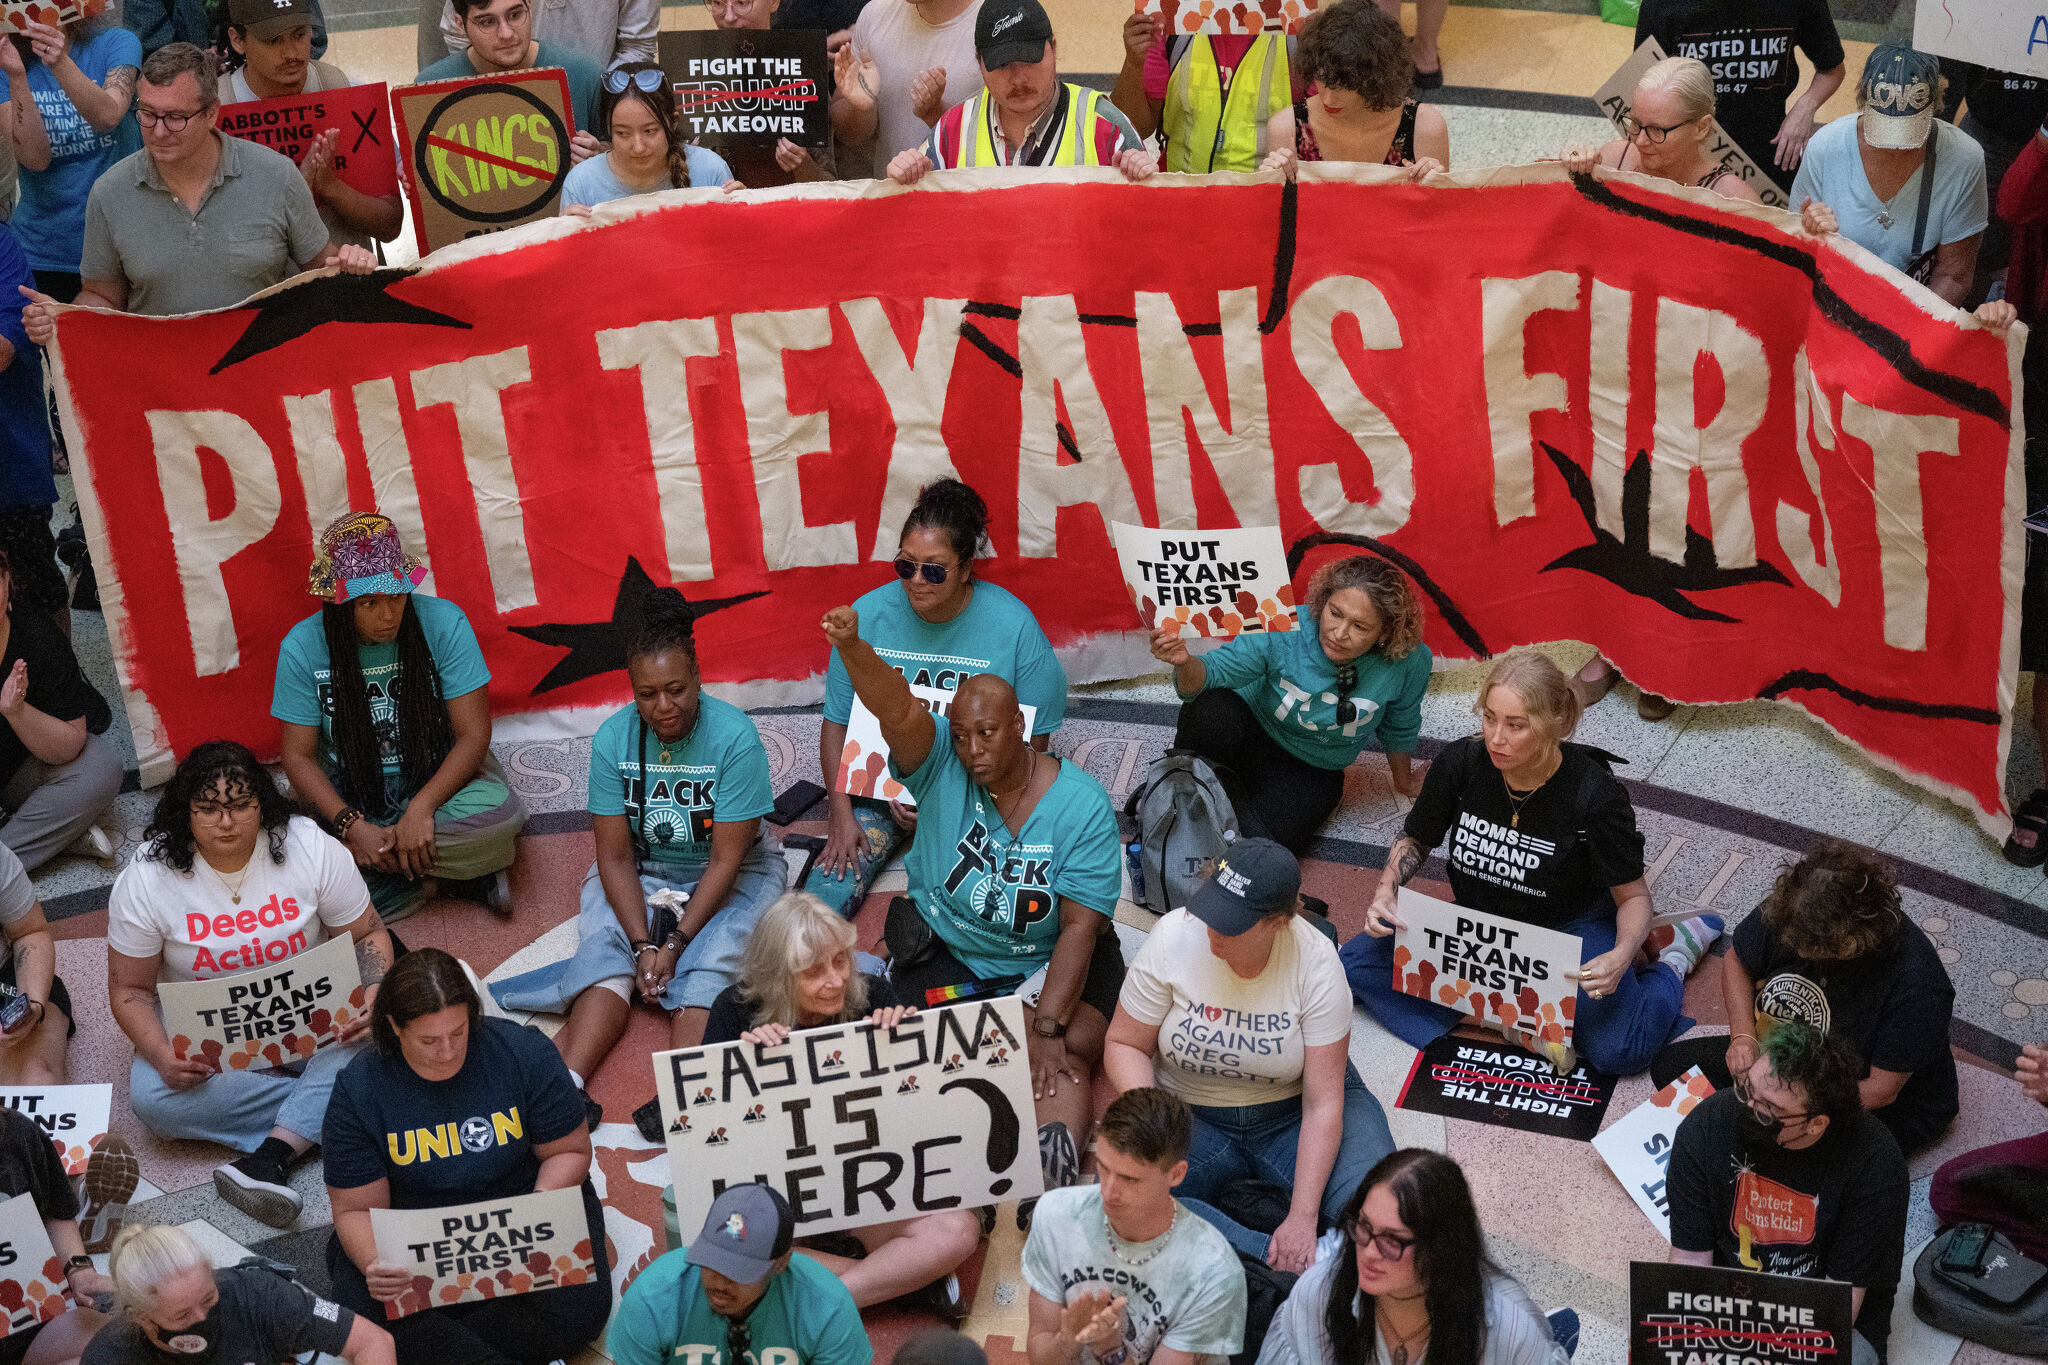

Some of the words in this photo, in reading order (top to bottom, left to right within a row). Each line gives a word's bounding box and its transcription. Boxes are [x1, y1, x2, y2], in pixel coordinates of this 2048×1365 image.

[1678, 39, 1744, 60] TASTED
[1751, 36, 1788, 55] LIKE
[688, 57, 757, 77] FIGHT
[761, 57, 802, 76] THE
[1710, 60, 1779, 80] SCISM
[673, 78, 817, 115] TRUMP
[1716, 83, 1731, 93] 86
[1733, 83, 1748, 94] 47
[2003, 79, 2019, 90] 86
[2022, 80, 2038, 90] 47
[38, 104, 64, 117] ARE
[221, 103, 327, 133] ABBOTT'S
[689, 115, 806, 134] TAKEOVER
[68, 125, 94, 141] THE
[99, 134, 118, 149] IS.
[428, 113, 558, 197] KINGS
[145, 345, 538, 678] PUT
[595, 275, 1413, 584] TEXANS
[1481, 269, 1960, 652] FIRST
[1160, 540, 1220, 562] PUT
[1136, 559, 1259, 584] TEXANS
[1157, 583, 1242, 606] FIRST
[1459, 811, 1520, 846] MOMS
[1452, 844, 1526, 882] ACTION
[1455, 827, 1540, 869] DEMAND
[1462, 866, 1477, 878] GUN
[1478, 870, 1502, 886] SENSE
[1502, 879, 1511, 888] IN
[1512, 883, 1547, 898] AMERICA
[186, 893, 301, 942] Deeds
[1456, 916, 1519, 950] PUT
[192, 930, 308, 973] Action
[1424, 927, 1549, 981] TEXANS
[228, 969, 294, 1005] PUT
[1441, 954, 1528, 996] FIRST
[196, 976, 333, 1027] TEXANS
[1779, 994, 1803, 1007] UNIQUE
[1786, 1000, 1803, 1016] LABEL
[223, 1004, 316, 1044] FIRST
[1178, 1018, 1285, 1056] AGAINST
[670, 1002, 1020, 1112] FASCISM
[1171, 1033, 1241, 1067] GREG
[1456, 1046, 1588, 1081] TKEOVER
[1432, 1060, 1595, 1106] TRUMP
[1441, 1083, 1491, 1105] THE
[1494, 1093, 1573, 1118] FIGHT
[387, 1106, 523, 1166] UNION
[782, 1086, 881, 1160] IS
[712, 1136, 962, 1224] ERE
[442, 1208, 512, 1238] PUT
[1771, 1212, 1803, 1233] kids!
[408, 1222, 555, 1263] TEXANS
[435, 1246, 534, 1278] FIRST
[1667, 1291, 1753, 1317] FIGHT
[1758, 1301, 1815, 1327] THE
[1646, 1313, 1836, 1362] TRUMP
